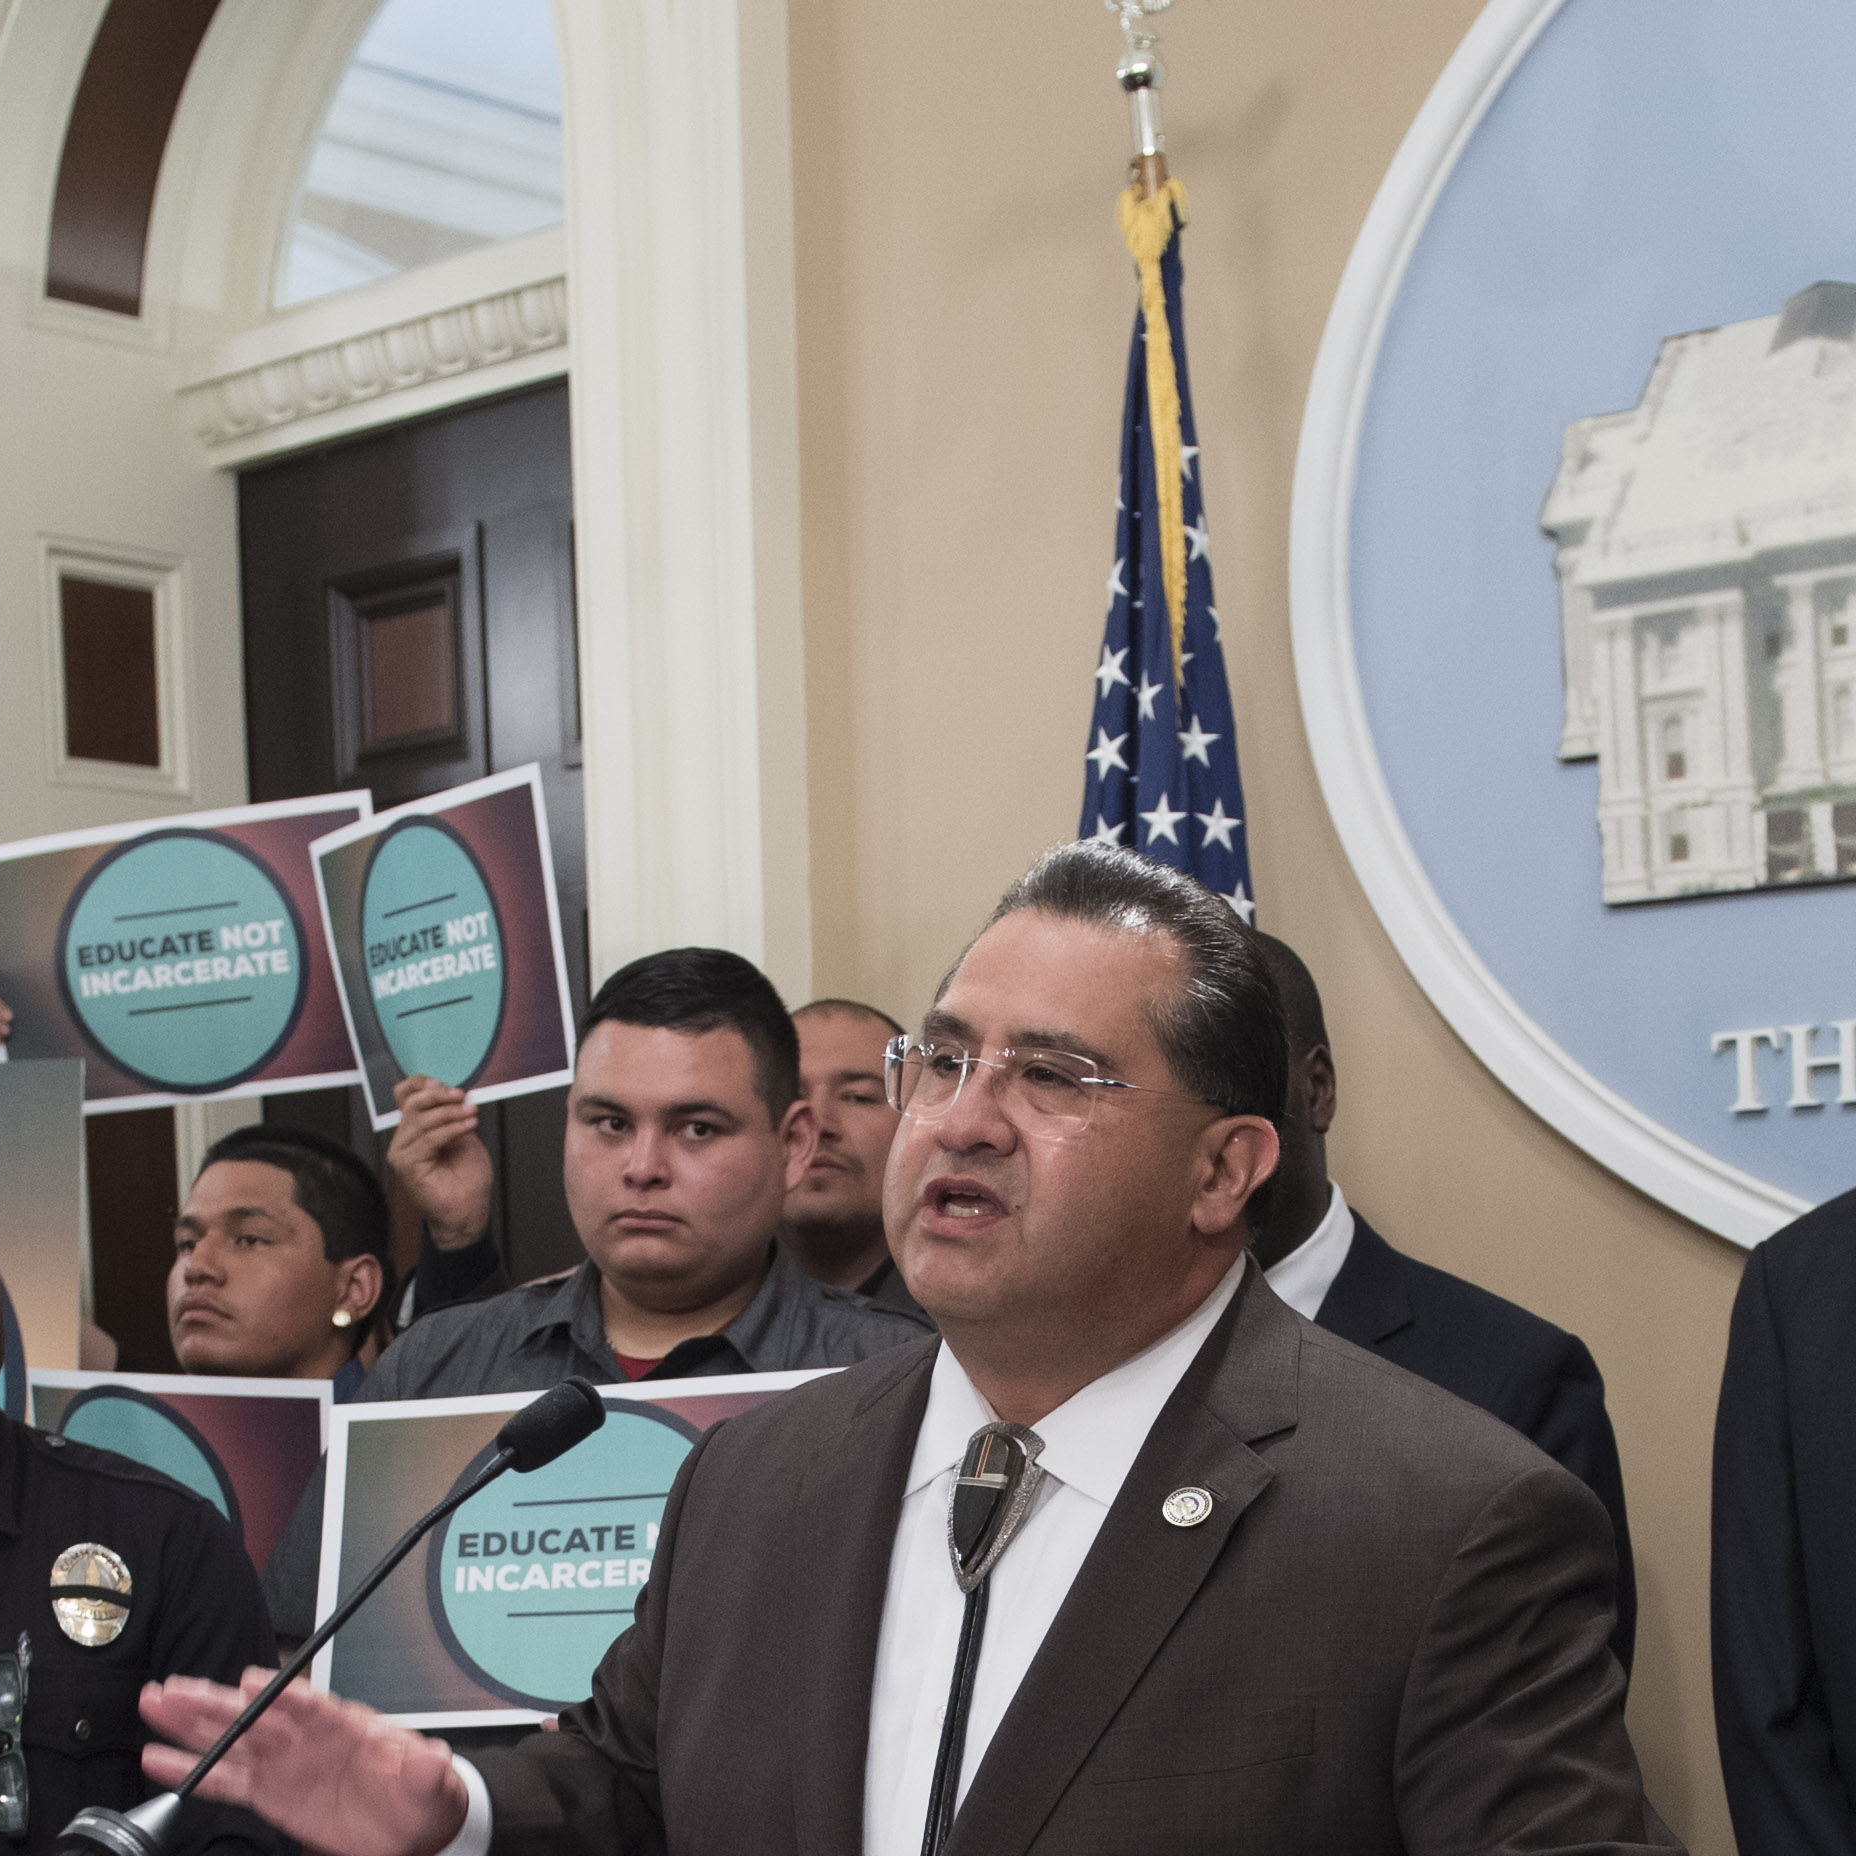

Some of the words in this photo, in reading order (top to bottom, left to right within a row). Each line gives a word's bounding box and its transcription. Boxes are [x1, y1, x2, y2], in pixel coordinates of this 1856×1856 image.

[78, 930, 215, 967] EDUCATE
[220, 918, 284, 950] NOT
[369, 930, 445, 967] EDUCATE
[445, 910, 490, 947] NOT
[79, 948, 292, 998] INCARCERATE
[373, 943, 496, 999] INCARCERATE
[457, 1523, 636, 1558] EDUCATE
[455, 1557, 651, 1593] INCARCER
